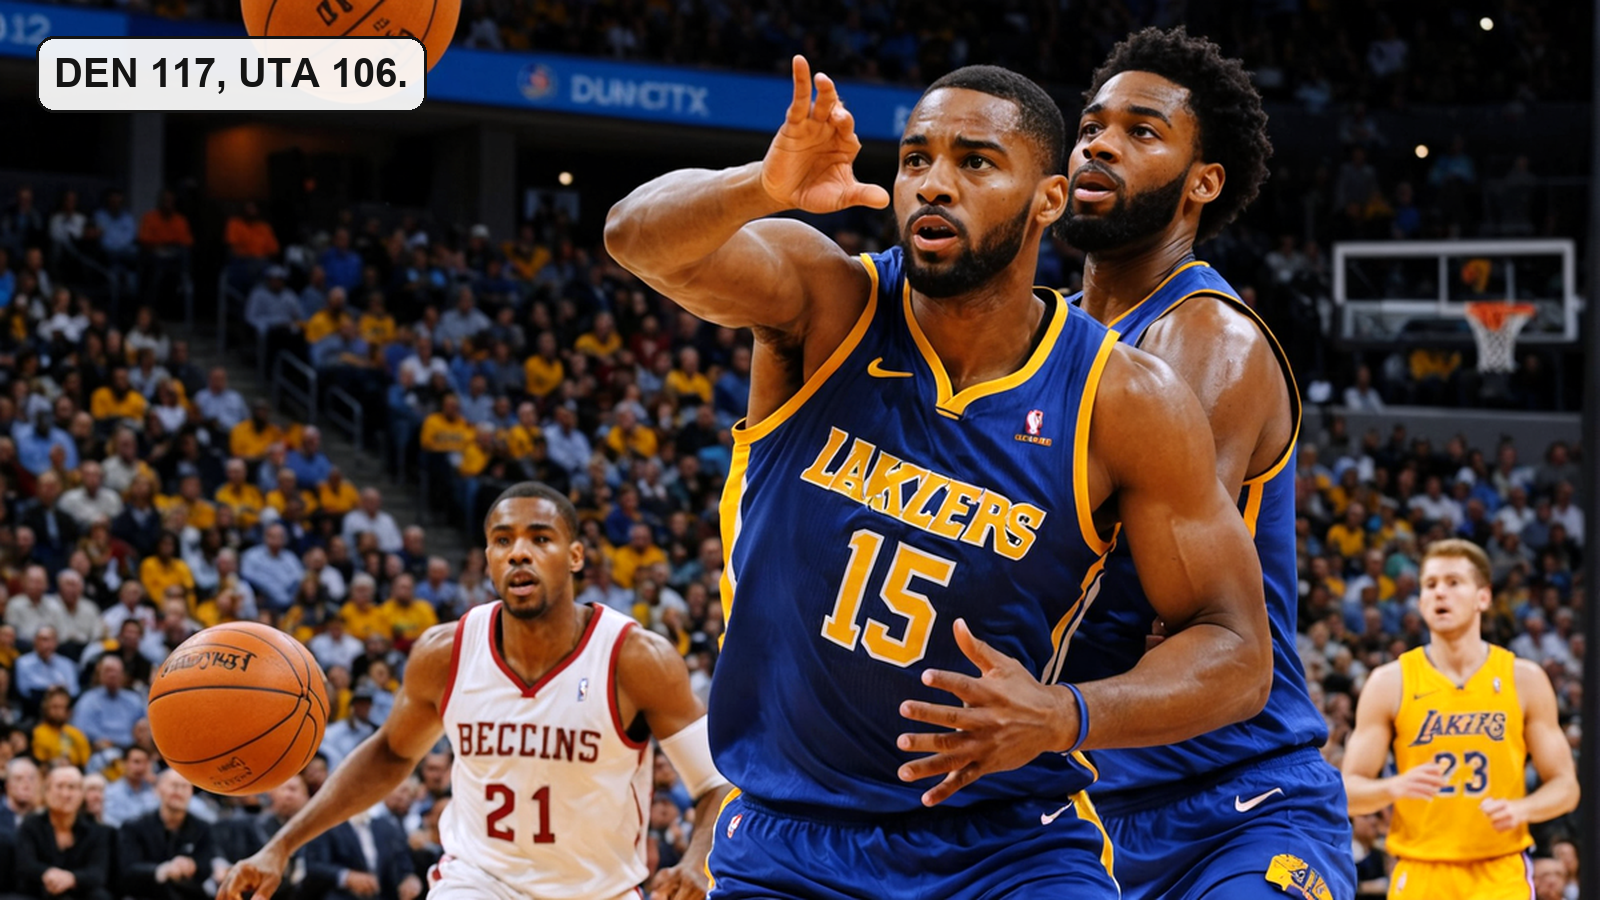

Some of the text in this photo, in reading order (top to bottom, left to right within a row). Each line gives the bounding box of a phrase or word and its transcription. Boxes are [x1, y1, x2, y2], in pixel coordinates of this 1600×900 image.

[821, 528, 957, 668] 15
[1434, 751, 1488, 793] 23
[485, 783, 556, 844] 21
